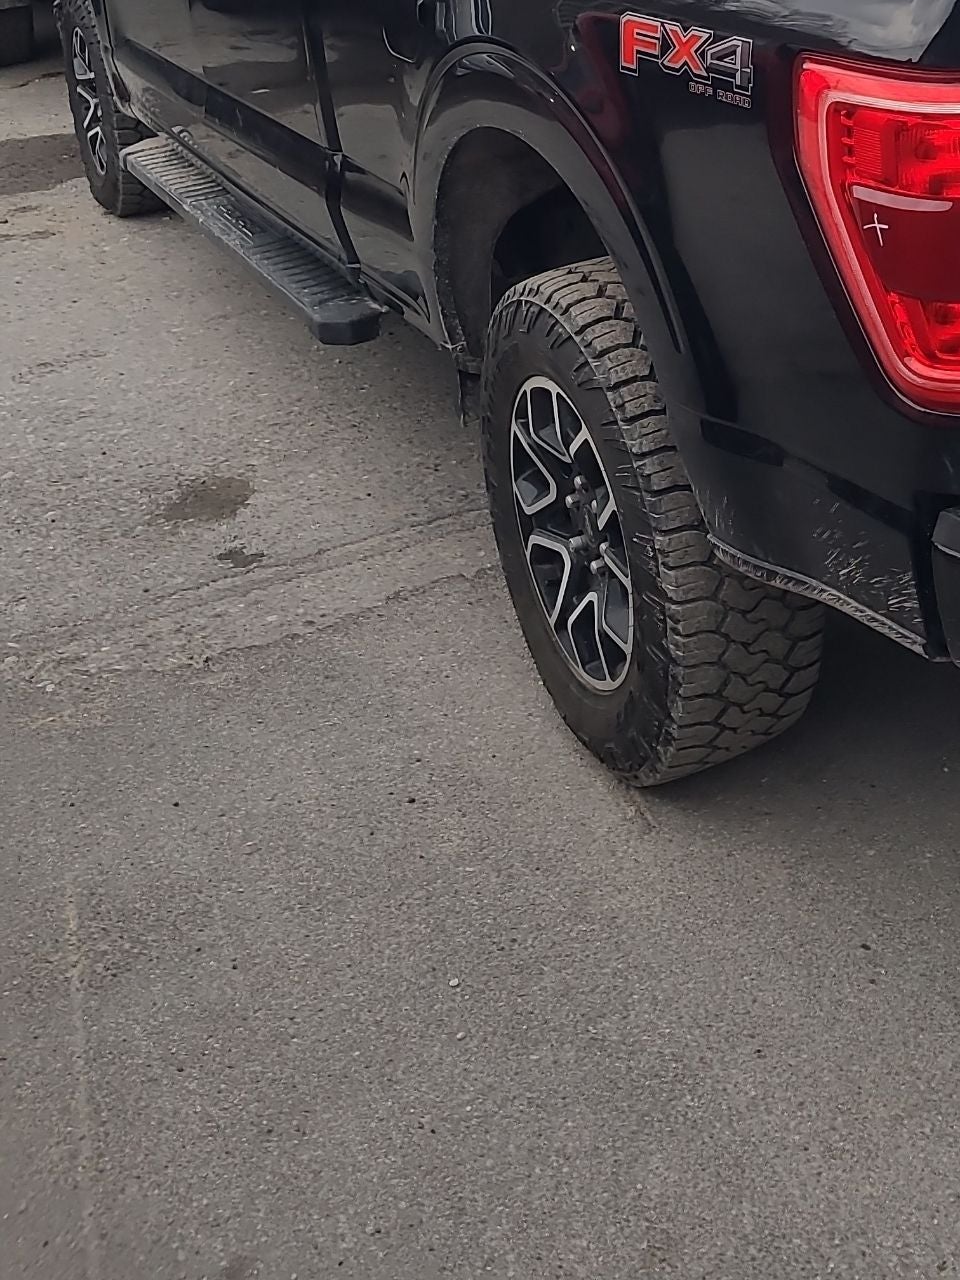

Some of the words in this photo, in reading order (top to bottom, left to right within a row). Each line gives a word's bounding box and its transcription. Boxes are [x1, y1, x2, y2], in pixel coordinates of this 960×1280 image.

[619, 11, 754, 95] FX4
[688, 82, 714, 97] OFF
[716, 89, 752, 109] ROAD
